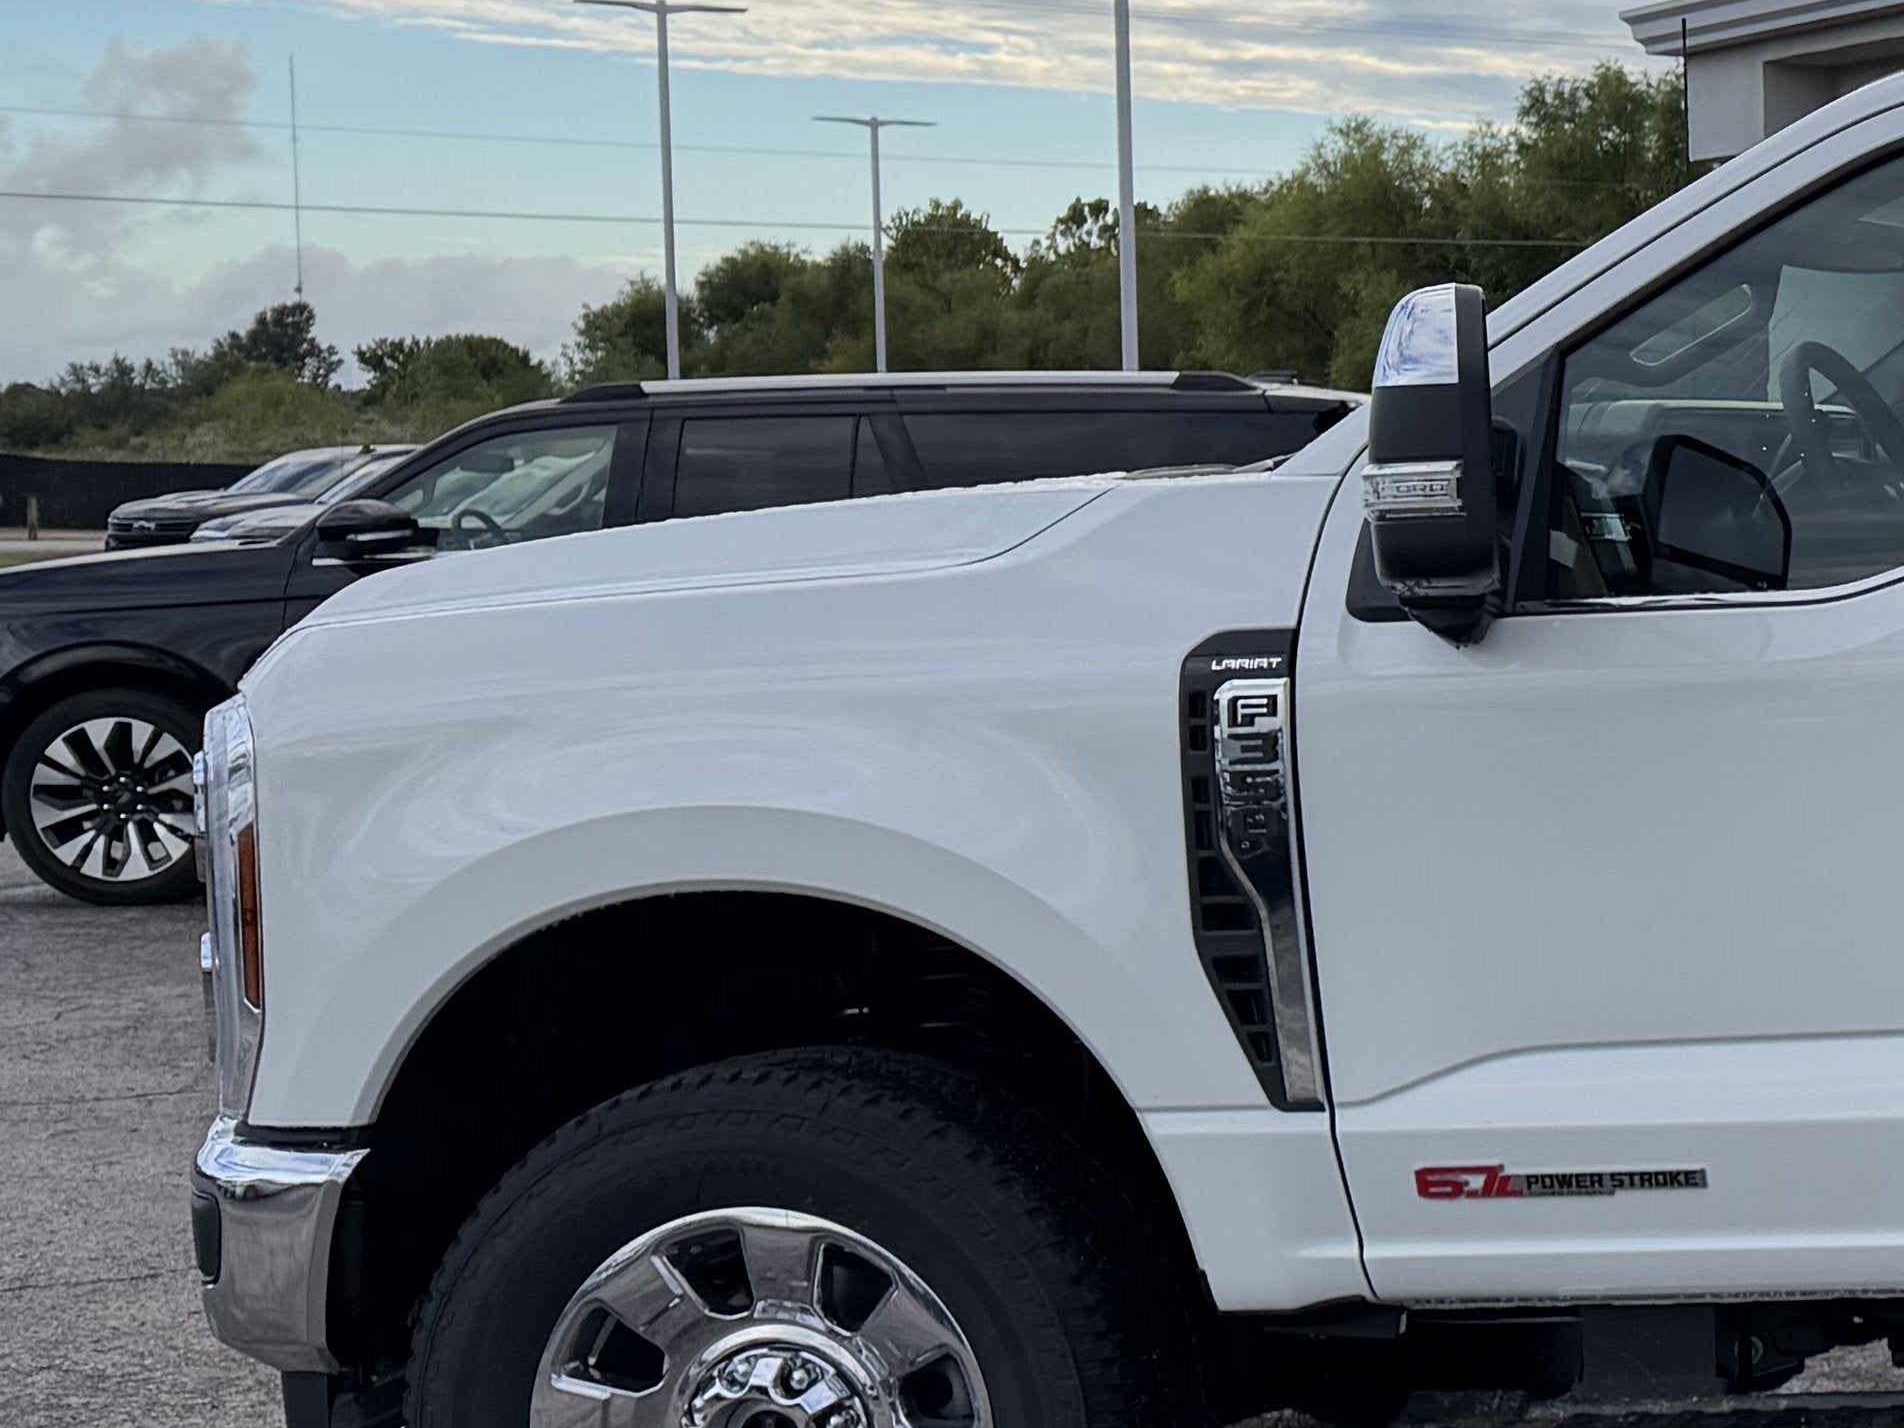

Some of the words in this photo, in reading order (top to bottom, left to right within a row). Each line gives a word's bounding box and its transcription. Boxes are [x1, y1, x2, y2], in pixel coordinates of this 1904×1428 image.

[1210, 656, 1283, 671] LARIAT
[1526, 1172, 1604, 1190] POWER
[1610, 1170, 1700, 1189] STROKE
